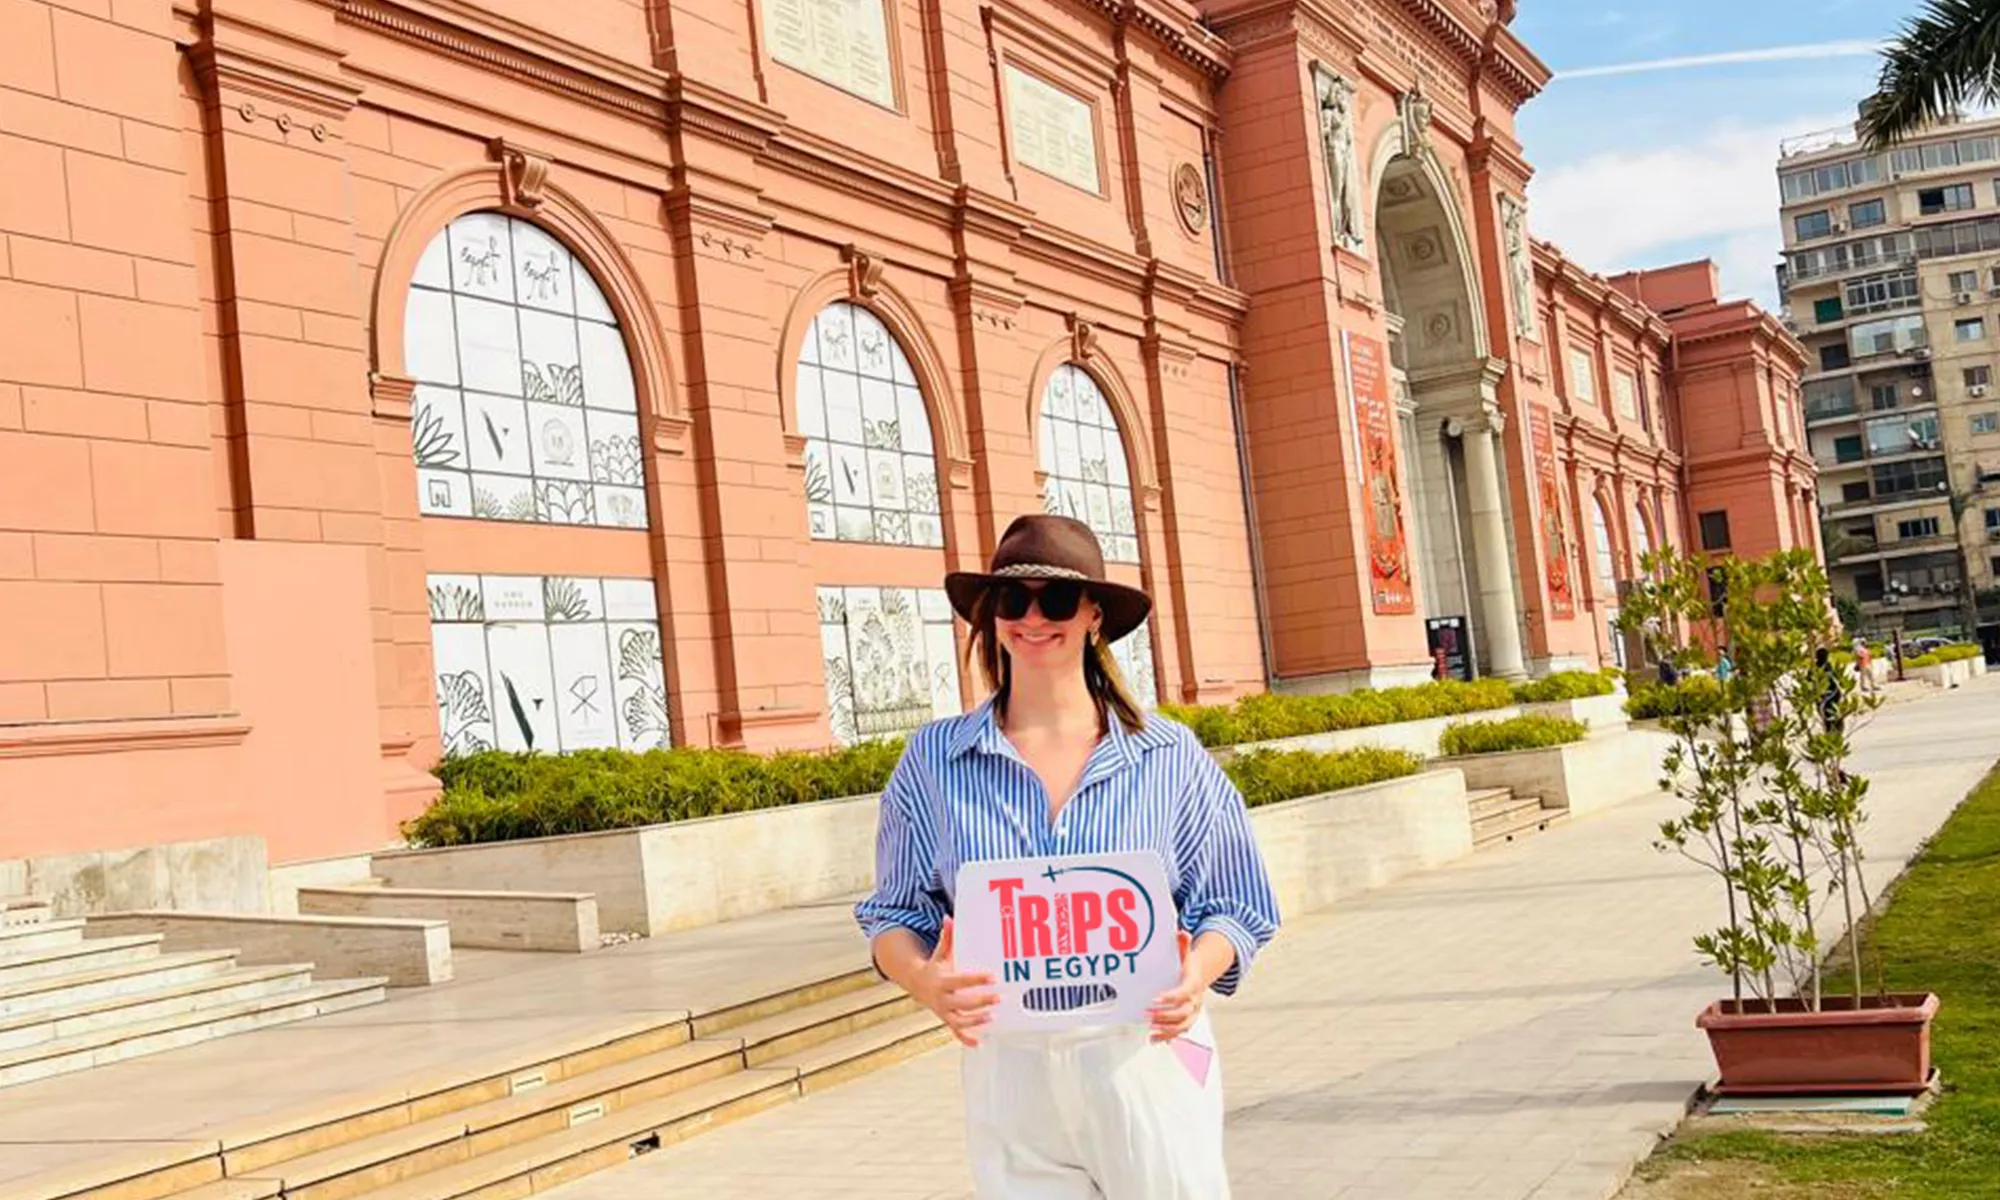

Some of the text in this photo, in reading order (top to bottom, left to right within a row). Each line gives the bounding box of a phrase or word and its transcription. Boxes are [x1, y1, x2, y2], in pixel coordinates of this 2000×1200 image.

[988, 878, 1139, 959] TRIPS
[1004, 952, 1138, 982] IN EGYPT
